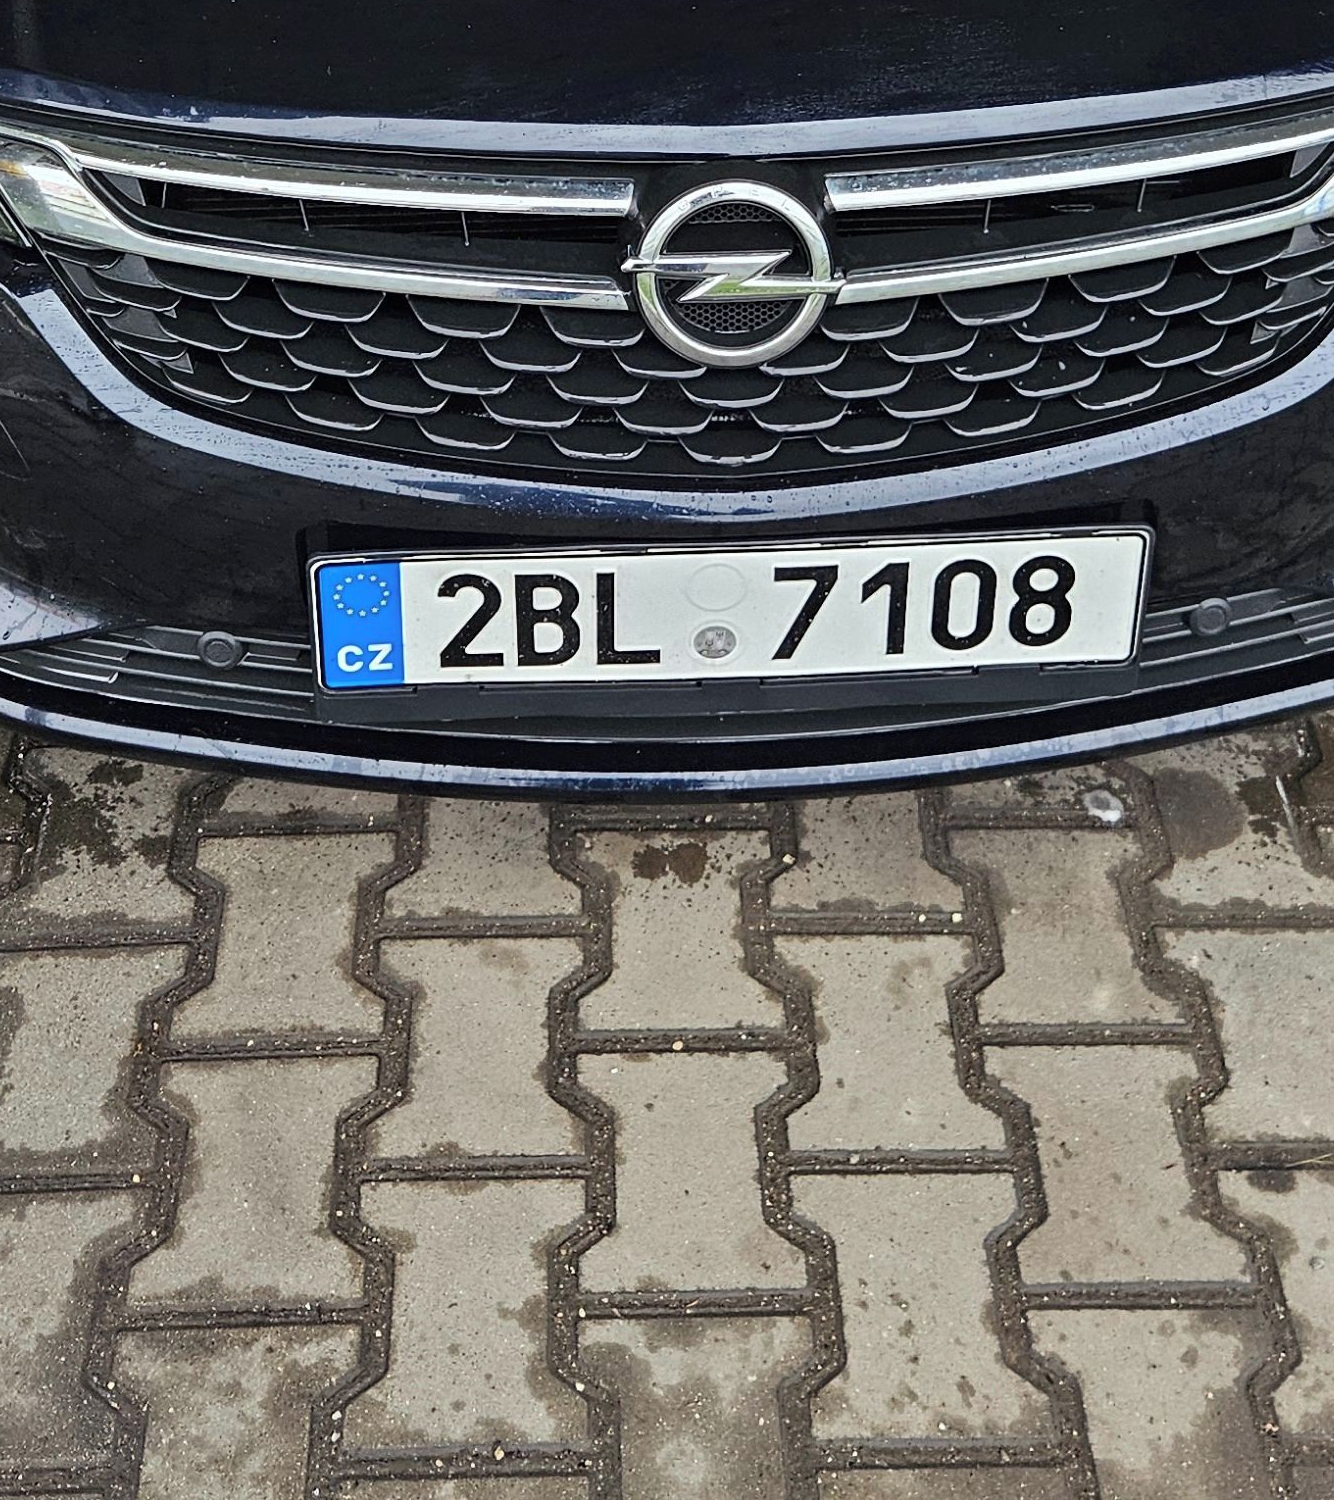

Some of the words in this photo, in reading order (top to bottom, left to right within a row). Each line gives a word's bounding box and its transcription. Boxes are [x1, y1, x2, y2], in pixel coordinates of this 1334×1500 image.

[437, 572, 661, 668] 2BL
[771, 555, 1076, 661] 7108
[337, 643, 394, 673] CZ
